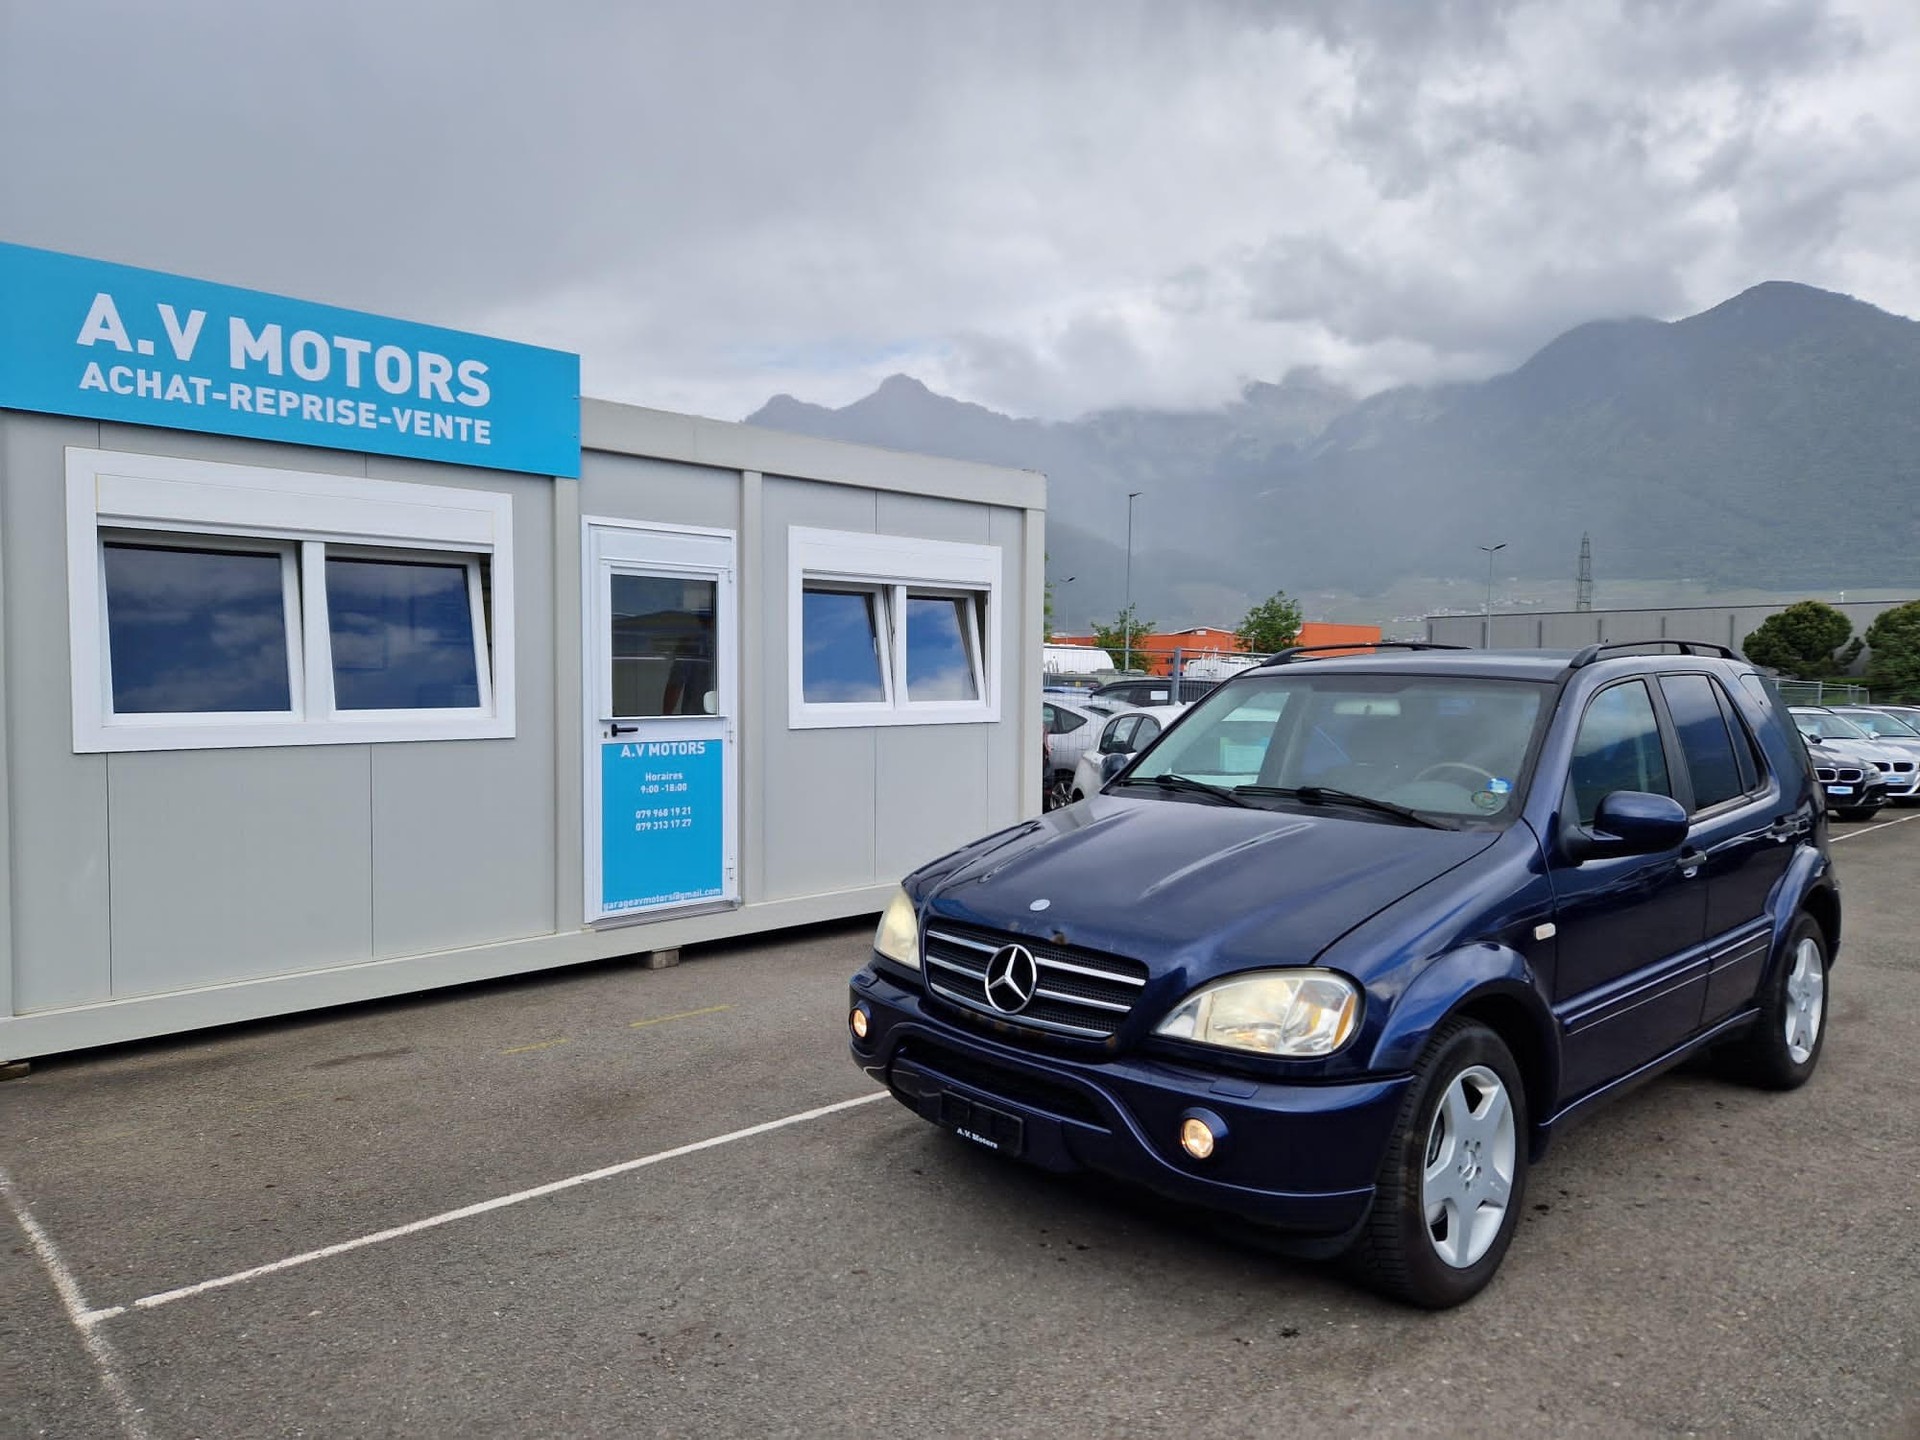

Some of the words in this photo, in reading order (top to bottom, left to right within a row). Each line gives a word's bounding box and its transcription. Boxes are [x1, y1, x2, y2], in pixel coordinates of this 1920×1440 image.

[76, 292, 207, 362] A.V
[228, 316, 492, 407] MOTORS
[78, 361, 492, 445] ACHAT-REPRISE-VENTE
[620, 743, 646, 758] A.V
[649, 741, 706, 757] MOTORS
[645, 771, 683, 781] Horaires
[640, 784, 659, 794] 9:00
[635, 809, 652, 819] 079
[670, 807, 681, 816] 19
[681, 806, 691, 815] 21
[635, 822, 652, 831] 079
[653, 820, 669, 830] 313
[670, 819, 681, 828] 17
[681, 818, 692, 828] 27
[972, 1133, 998, 1149] Motors
